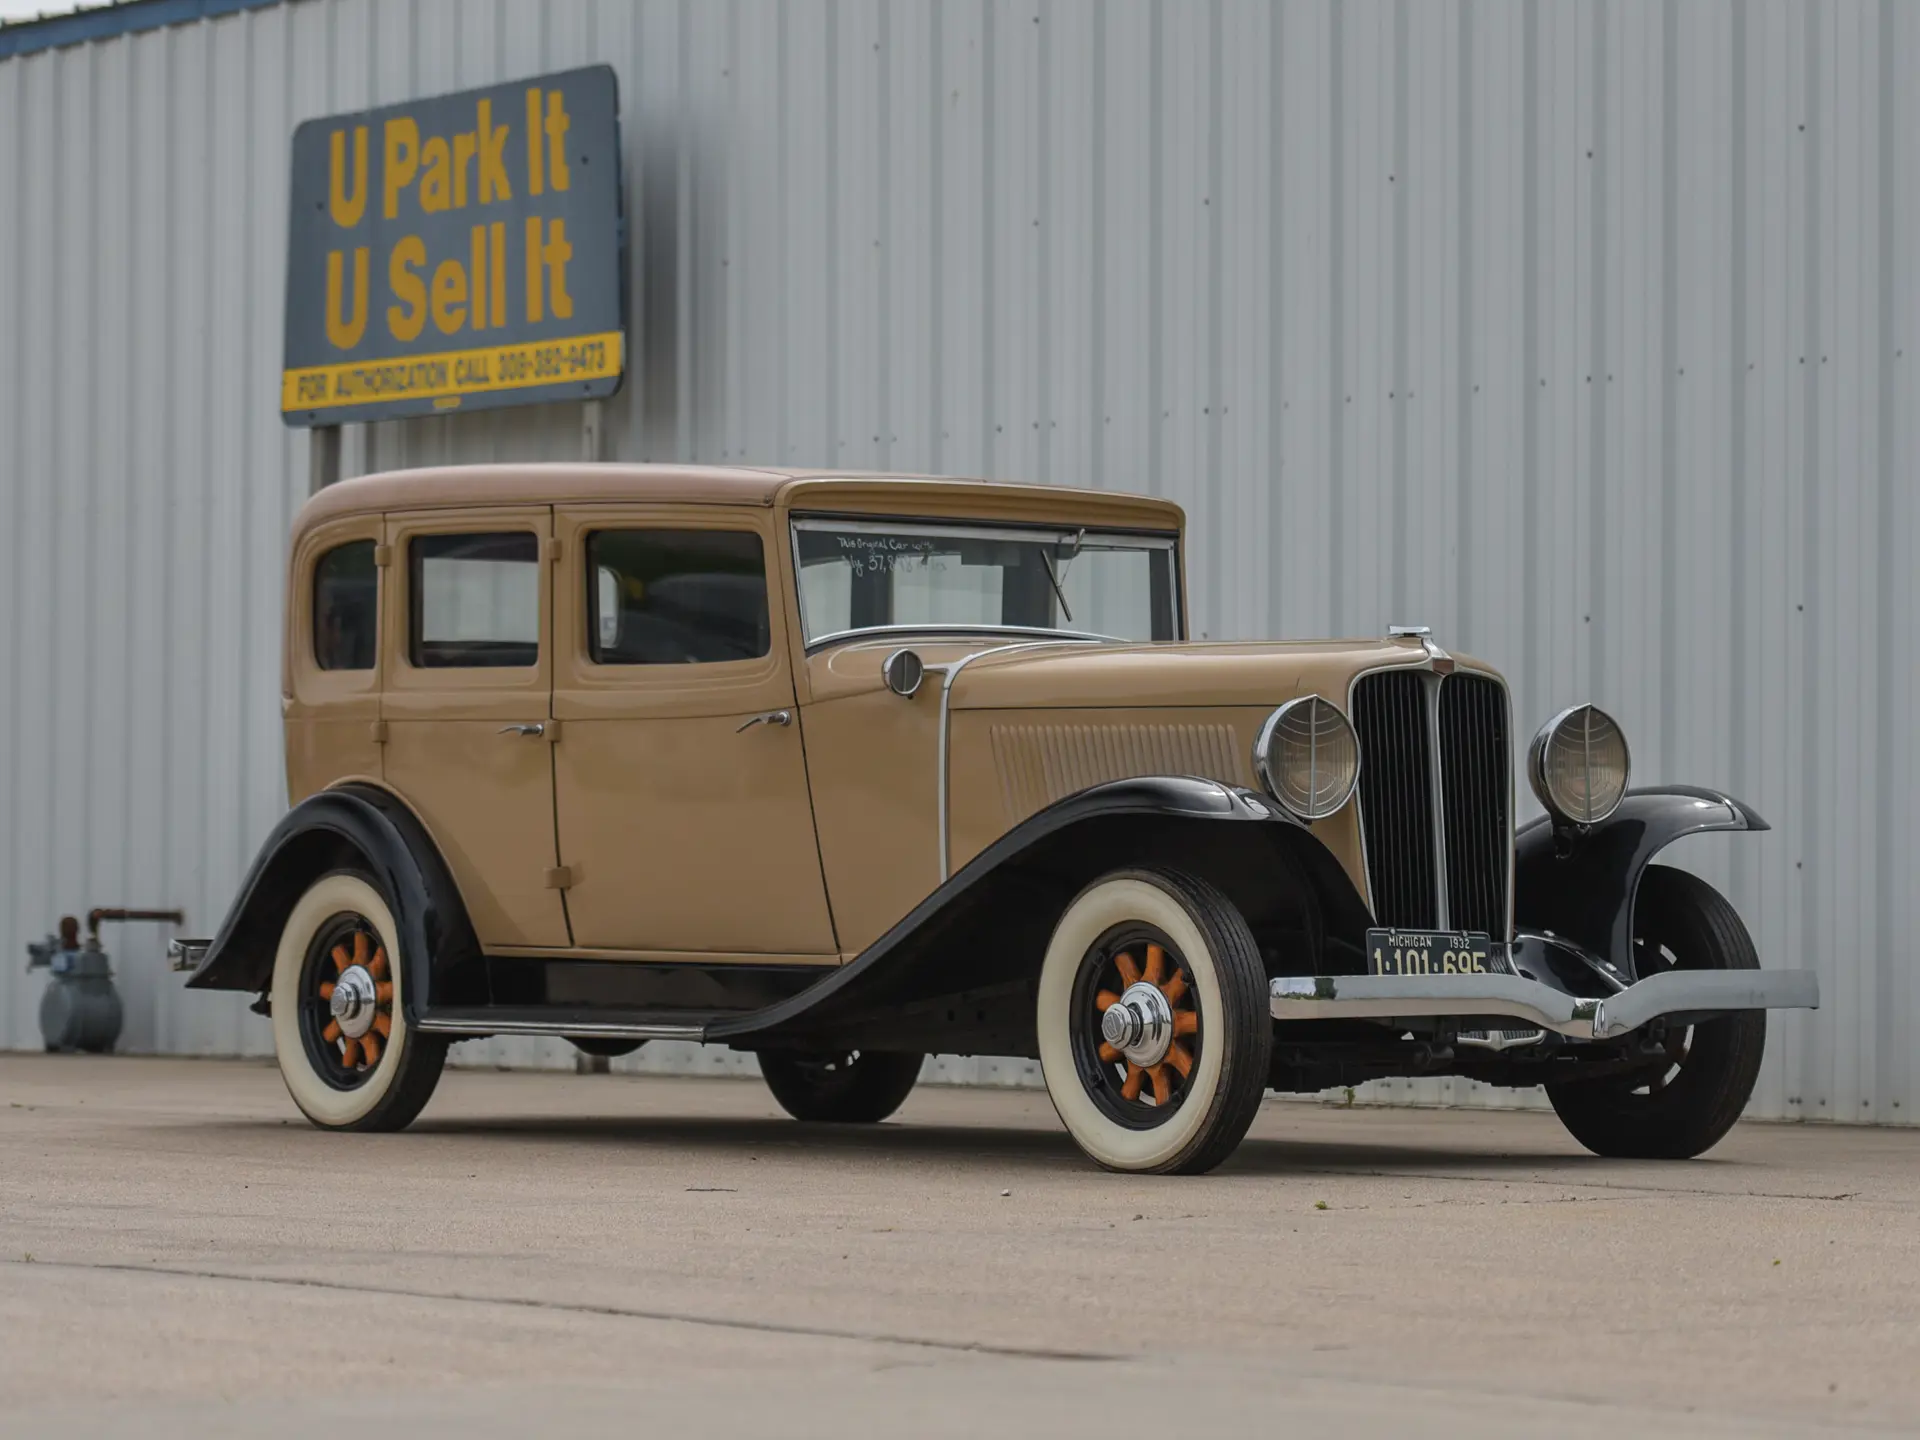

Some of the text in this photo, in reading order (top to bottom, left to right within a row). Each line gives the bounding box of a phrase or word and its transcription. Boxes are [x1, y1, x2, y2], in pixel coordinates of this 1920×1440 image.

[329, 87, 571, 228] U Park It
[325, 216, 574, 349] U Sell It
[297, 373, 328, 402] FOR
[334, 361, 448, 398] AUTHORIZATION
[456, 355, 491, 386] CALL
[837, 536, 856, 549] This
[889, 538, 909, 551] Car
[1388, 935, 1470, 949] MICHIGAN 1932
